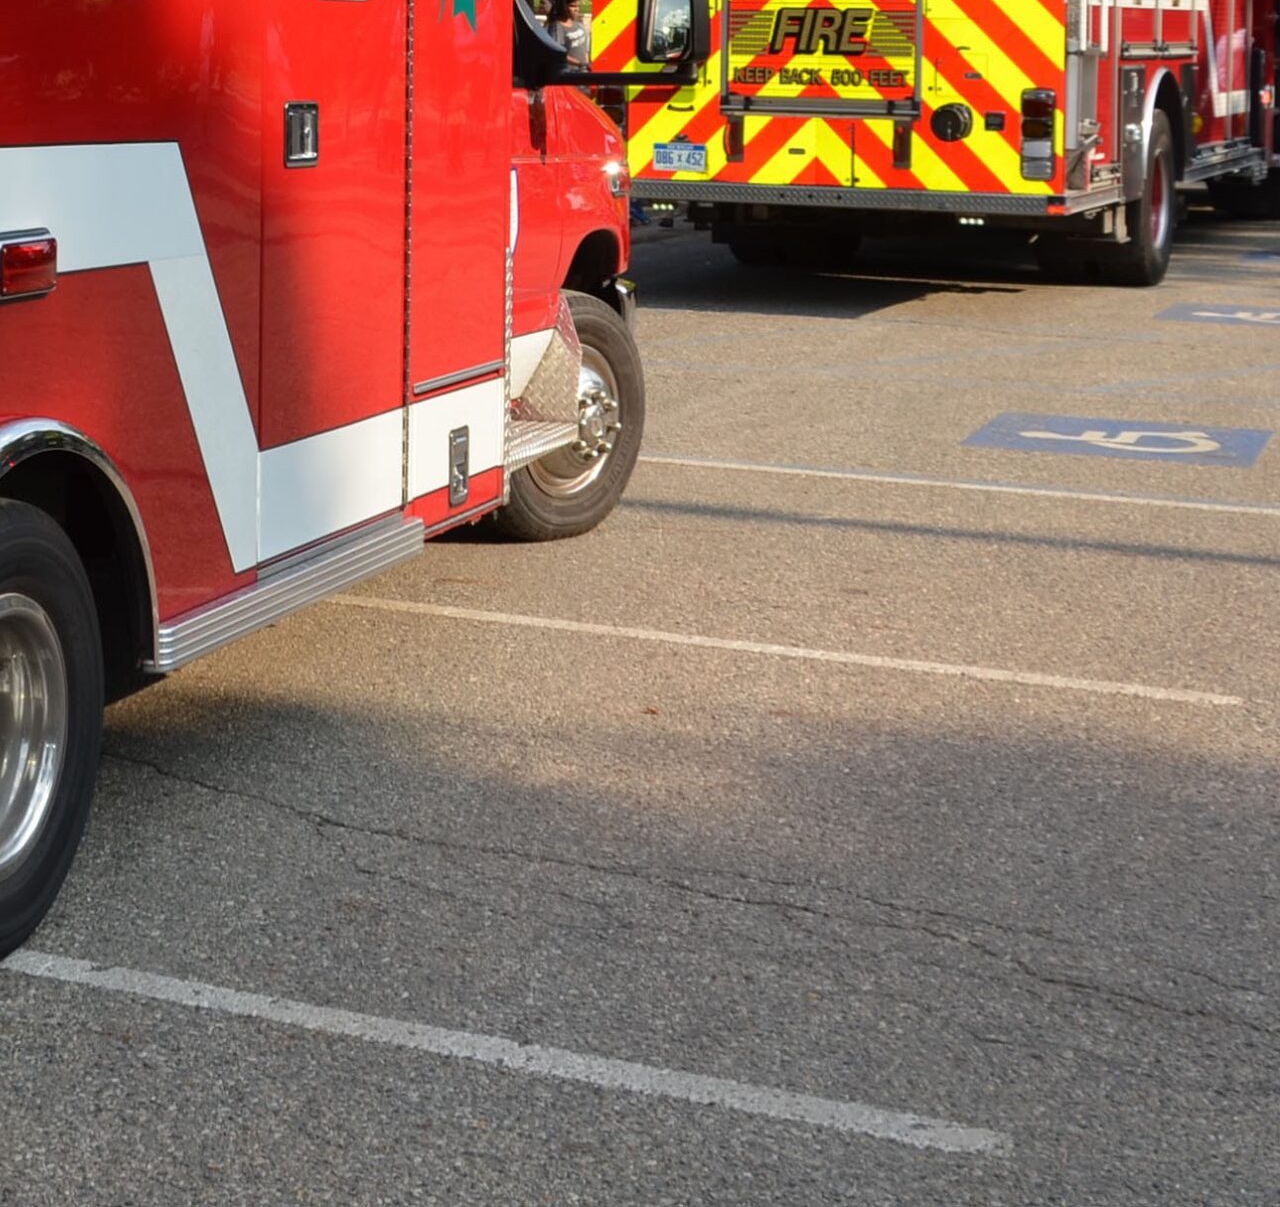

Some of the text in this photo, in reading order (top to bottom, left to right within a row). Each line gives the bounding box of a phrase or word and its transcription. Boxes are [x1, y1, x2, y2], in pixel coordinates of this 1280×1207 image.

[769, 7, 874, 55] FIRE
[734, 66, 910, 87] KEEP BACK 500 FEET
